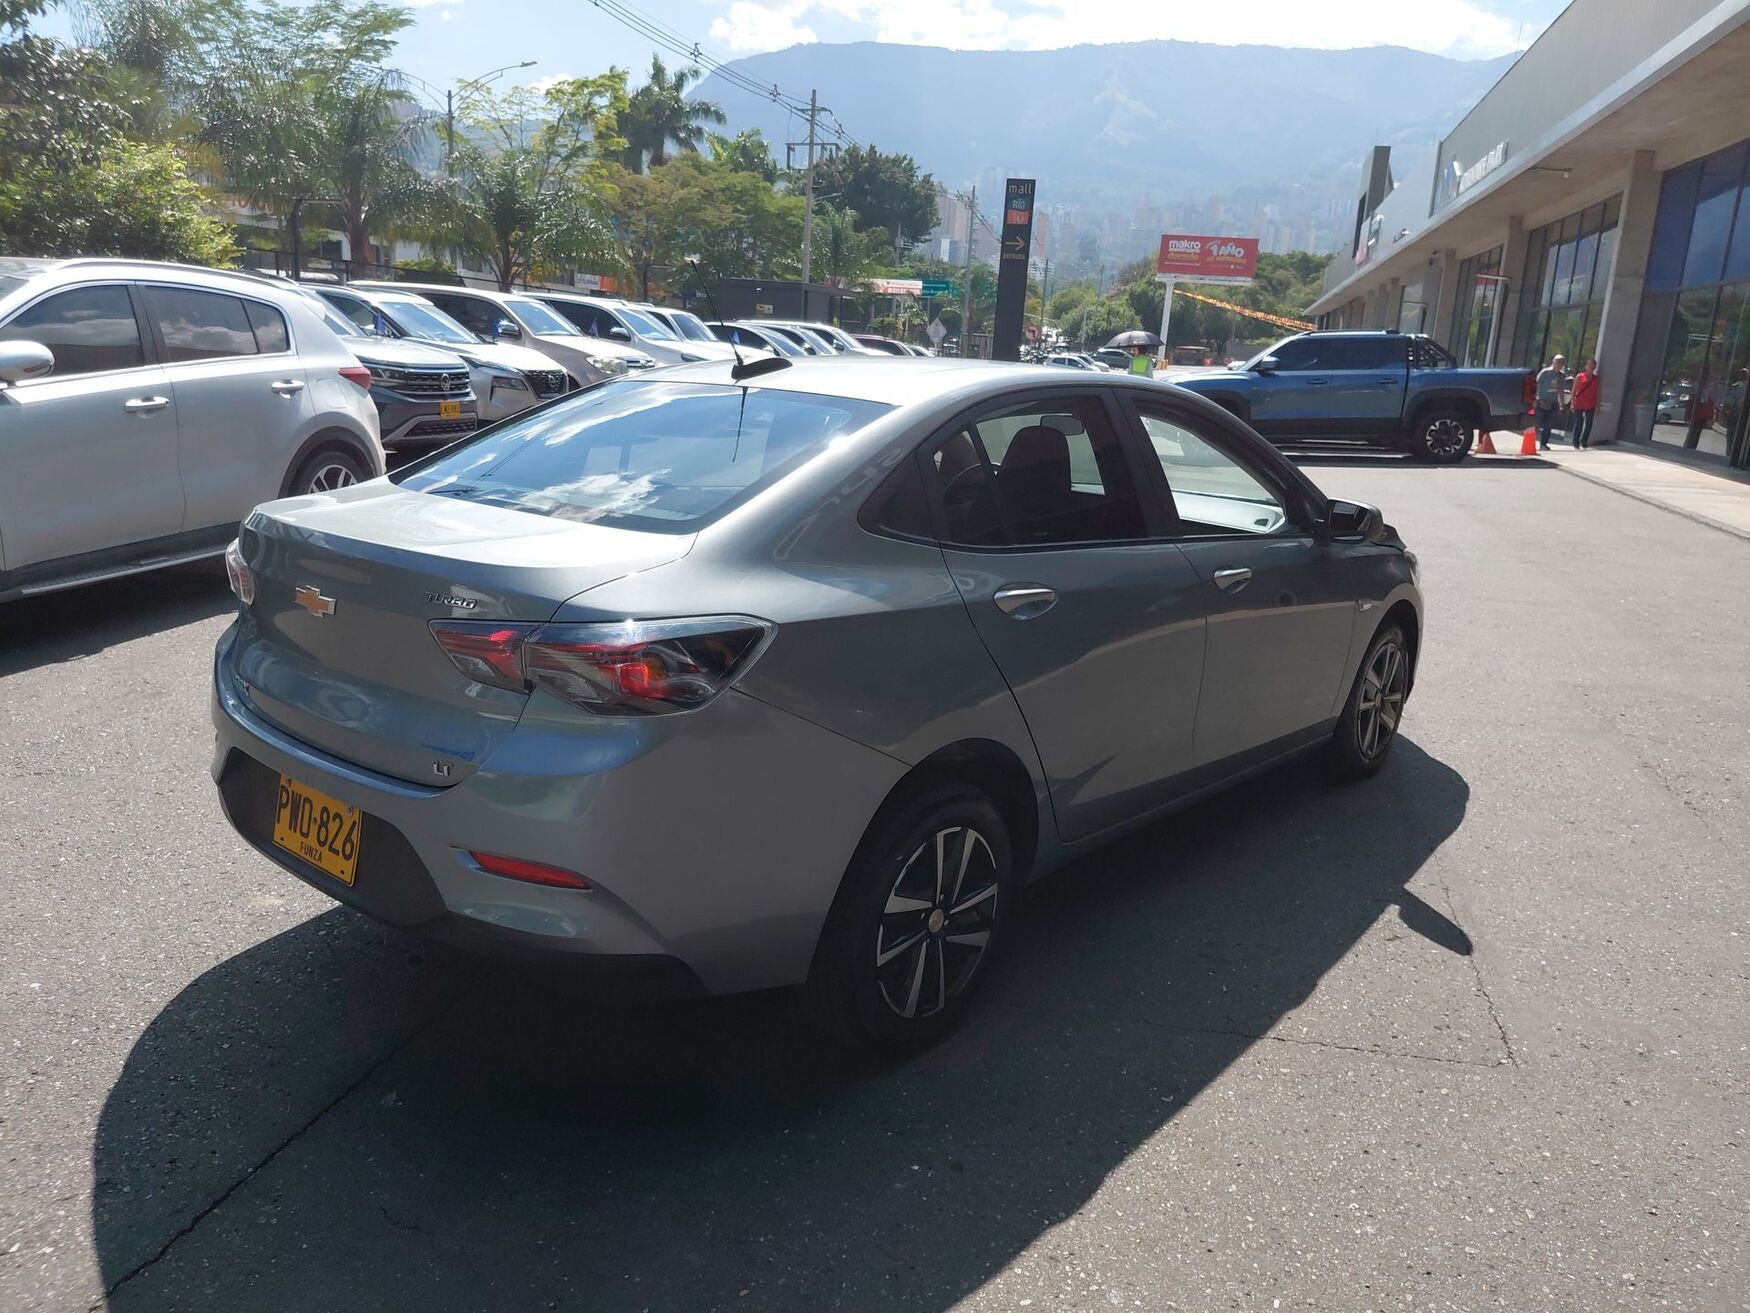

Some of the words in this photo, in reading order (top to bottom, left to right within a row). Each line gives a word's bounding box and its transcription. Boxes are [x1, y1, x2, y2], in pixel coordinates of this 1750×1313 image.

[1008, 183, 1031, 194] mall
[1169, 240, 1201, 250] makro
[424, 591, 478, 609] TURBO
[433, 760, 455, 777] LT
[300, 841, 322, 863] FUNZA
